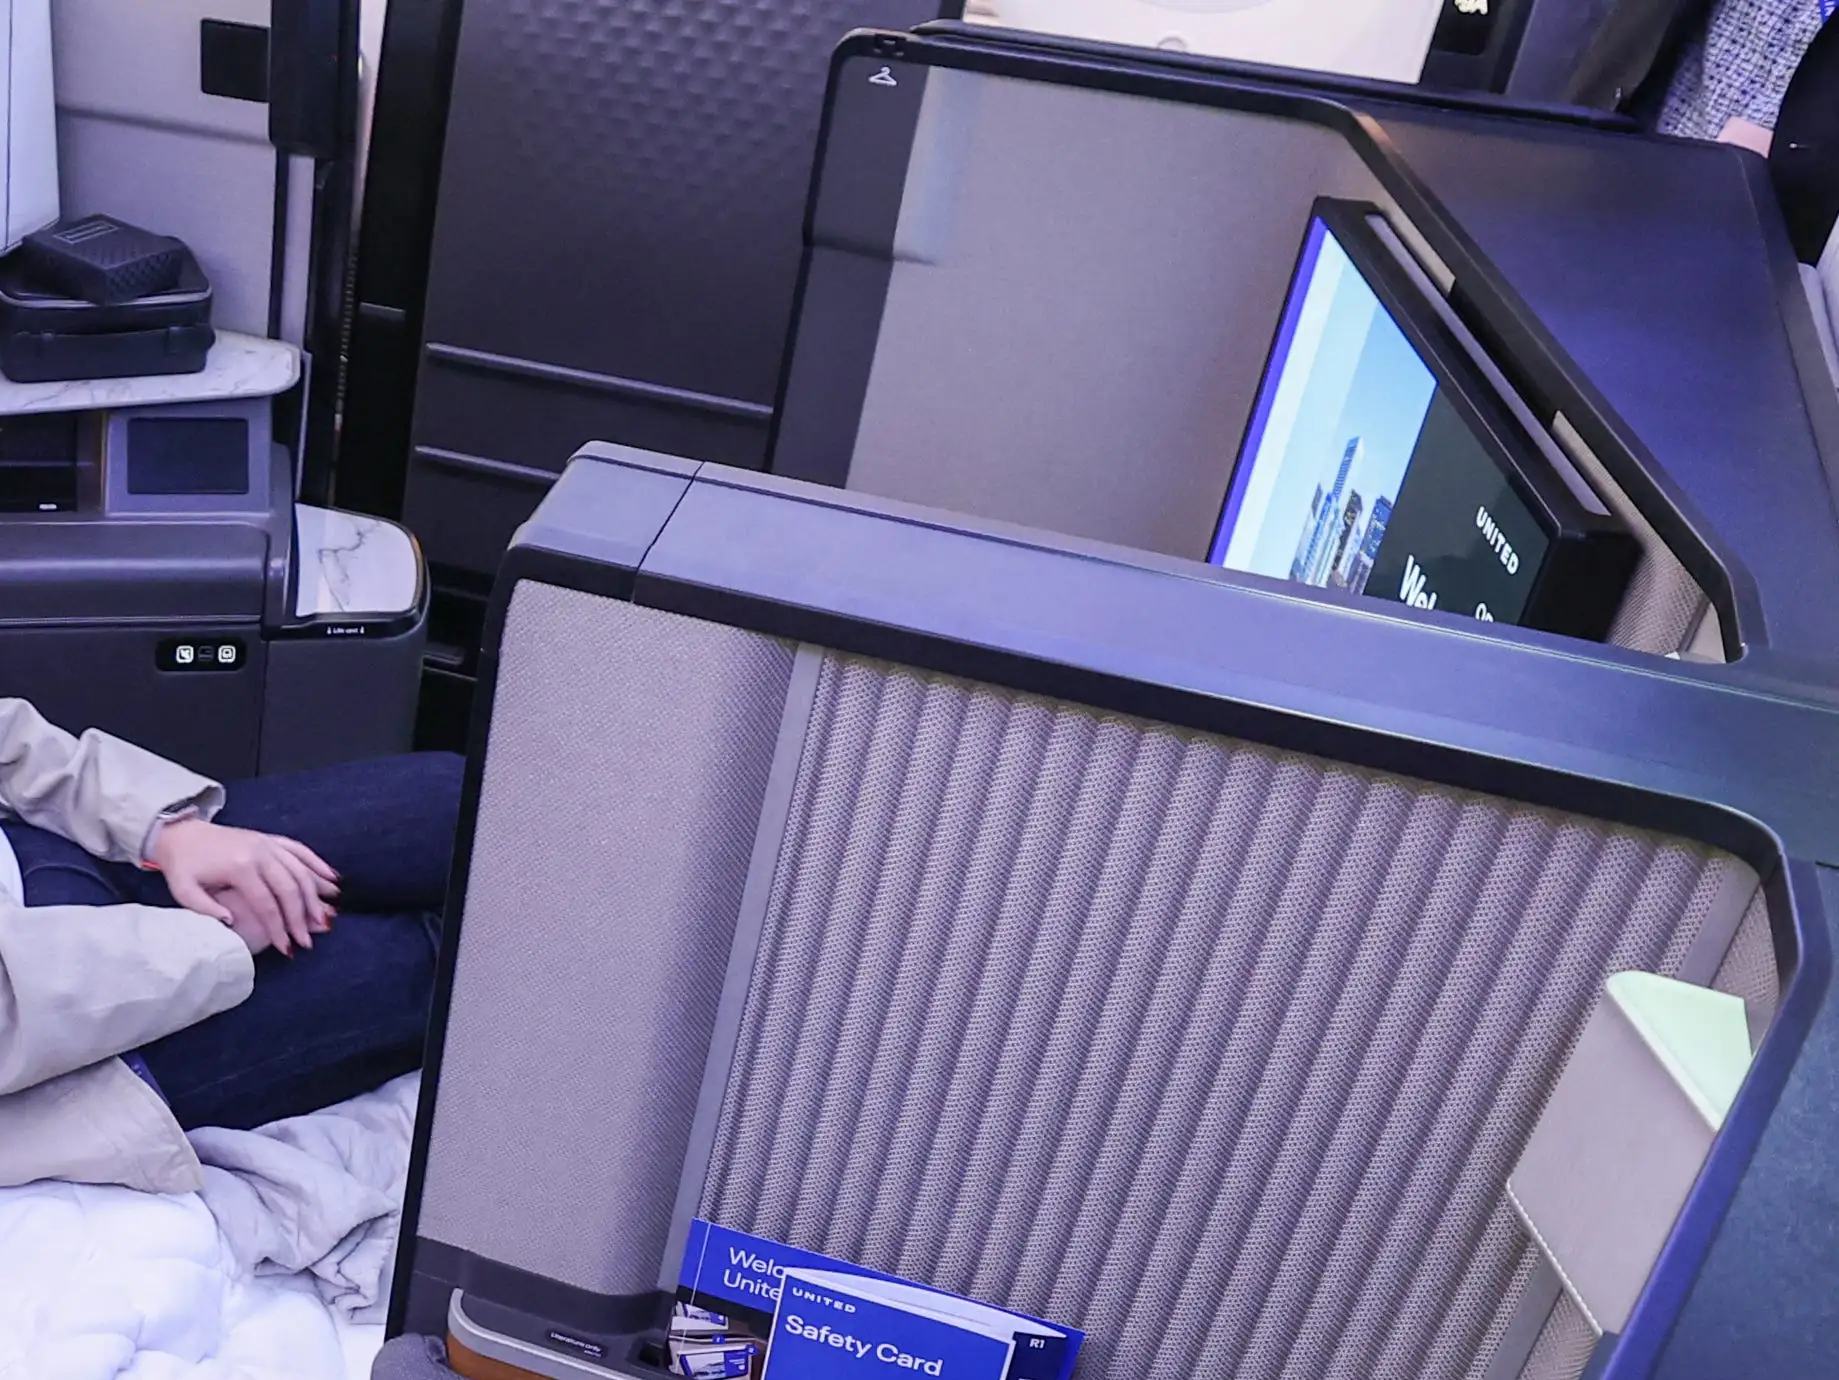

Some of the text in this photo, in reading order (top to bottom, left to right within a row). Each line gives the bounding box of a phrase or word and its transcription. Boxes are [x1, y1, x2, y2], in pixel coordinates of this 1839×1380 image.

[1476, 506, 1519, 574] UNITED
[723, 1268, 780, 1302] Unite
[792, 1286, 857, 1314] UNITED
[785, 1314, 944, 1377] Safety Card
[1029, 1338, 1045, 1349] R1
